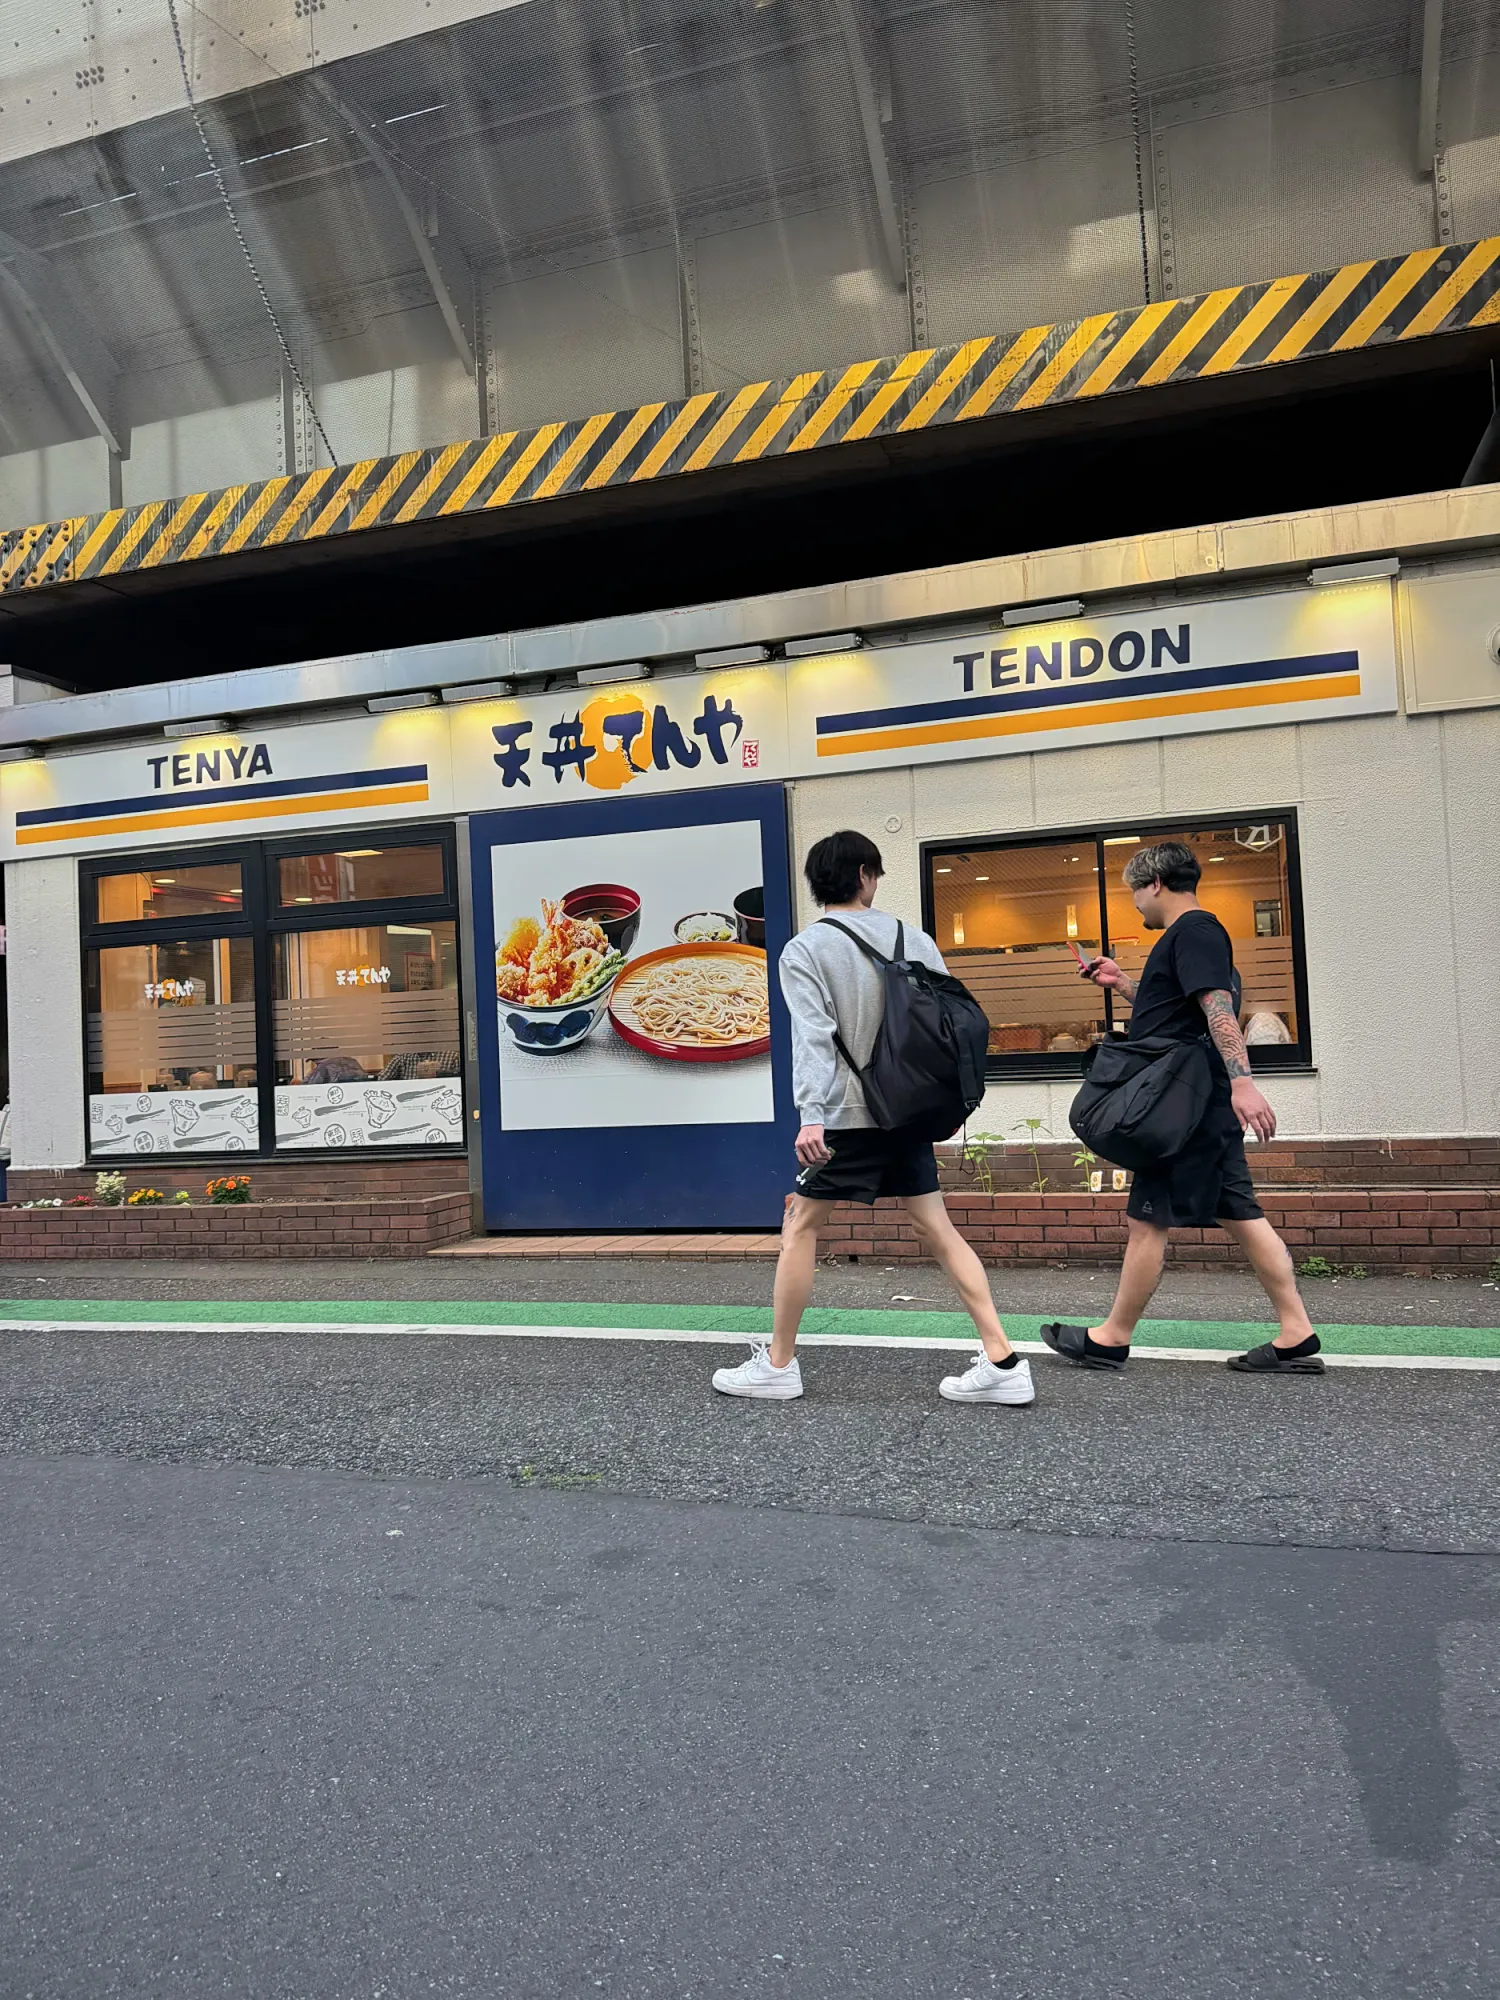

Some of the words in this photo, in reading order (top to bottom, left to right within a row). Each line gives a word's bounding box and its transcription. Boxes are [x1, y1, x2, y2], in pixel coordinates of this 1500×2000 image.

[953, 623, 1191, 692] TENDON
[147, 744, 273, 789] TENYA
[492, 695, 743, 788] 天丼てんや
